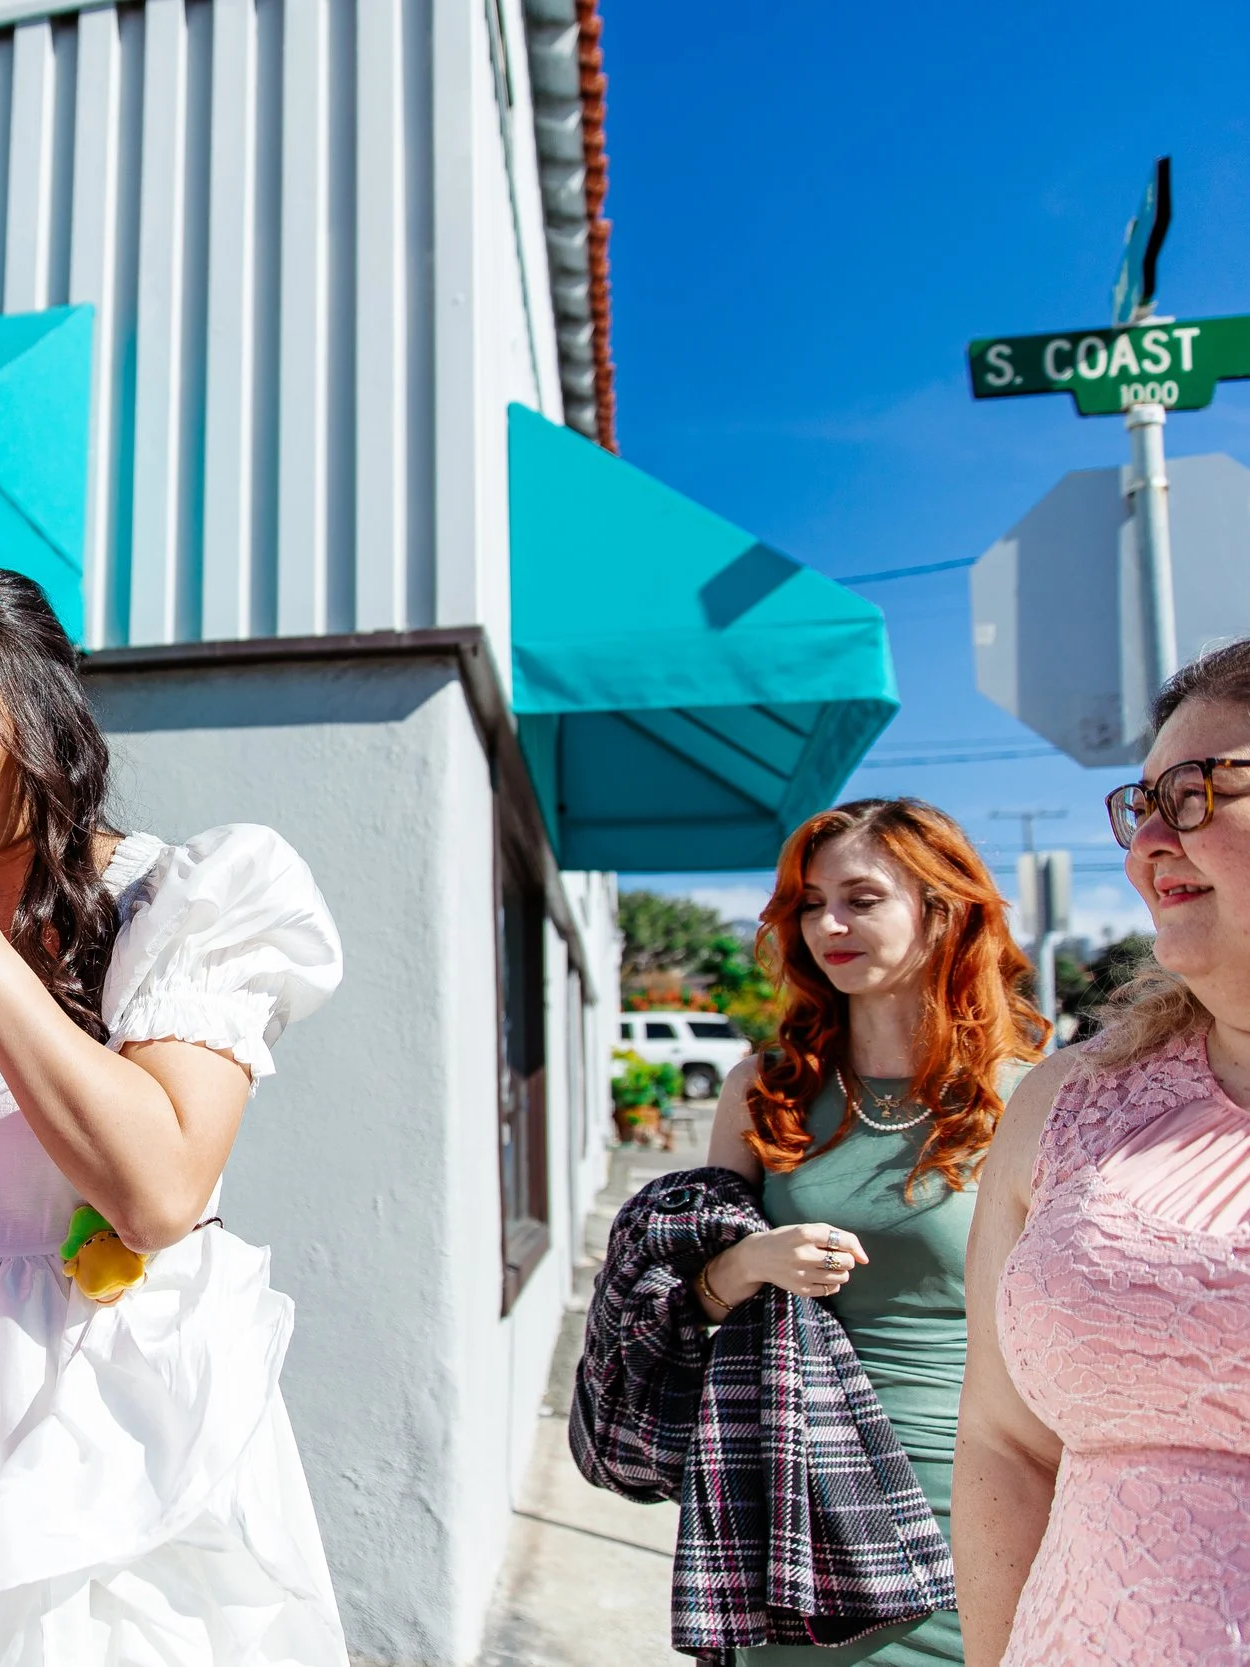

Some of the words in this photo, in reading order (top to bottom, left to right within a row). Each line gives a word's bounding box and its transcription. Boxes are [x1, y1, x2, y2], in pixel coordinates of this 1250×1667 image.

[985, 344, 1024, 387] S.
[1044, 327, 1201, 382] COAST
[1120, 380, 1179, 408] 1000
